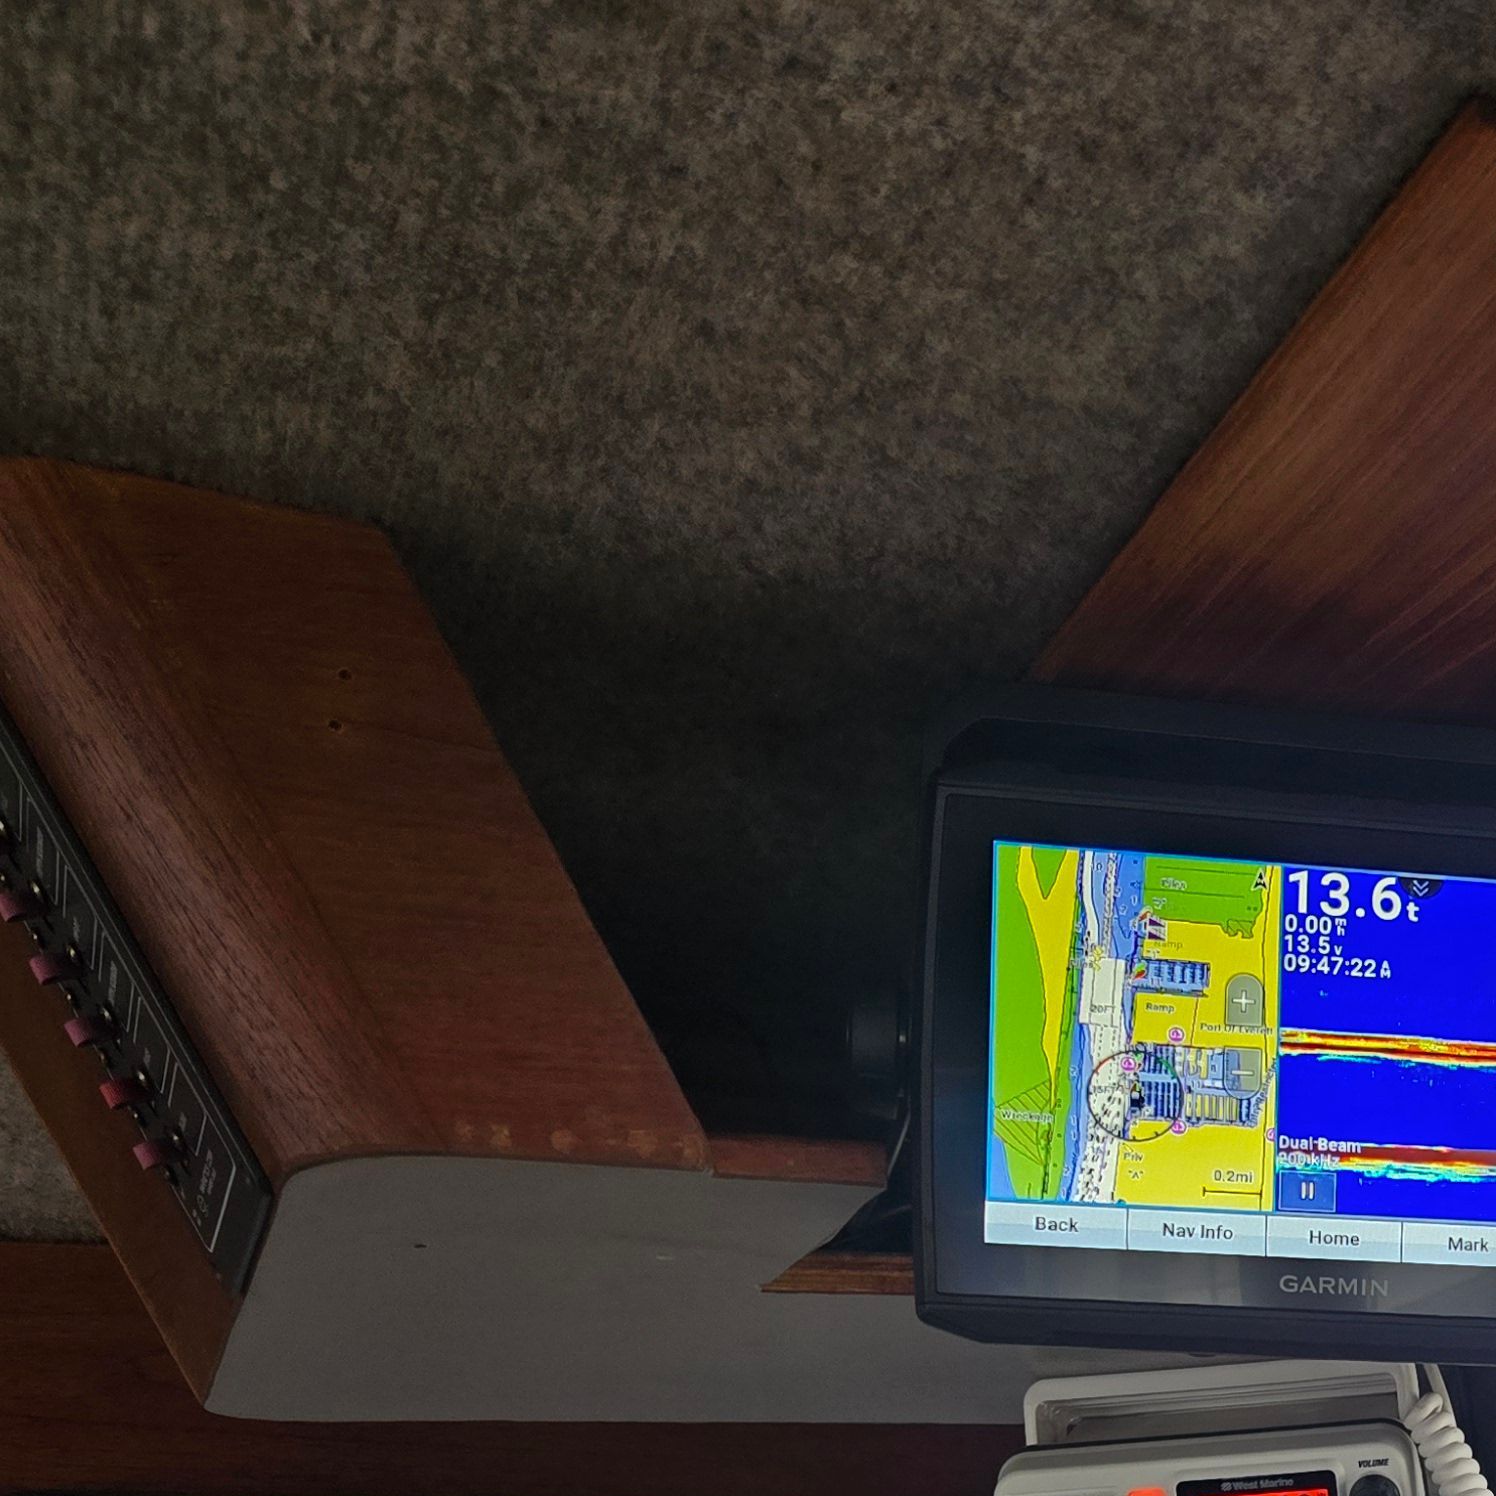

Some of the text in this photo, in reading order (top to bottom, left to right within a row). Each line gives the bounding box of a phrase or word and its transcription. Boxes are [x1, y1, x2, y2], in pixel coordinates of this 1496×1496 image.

[1288, 869, 1401, 921] 13.6
[1284, 914, 1332, 935] 0.00
[1284, 934, 1330, 955] 13.5
[1283, 953, 1376, 978] 09:47:22
[1278, 1135, 1361, 1153] Dual Beam
[1213, 1170, 1254, 1184] 0.2mi
[1035, 1216, 1079, 1233] Back
[1162, 1223, 1233, 1240] Nav Info
[1308, 1230, 1360, 1247] Home
[1448, 1235, 1489, 1253] Mark
[1279, 1274, 1388, 1298] GARMIN
[1358, 1457, 1389, 1468] VOLUME
